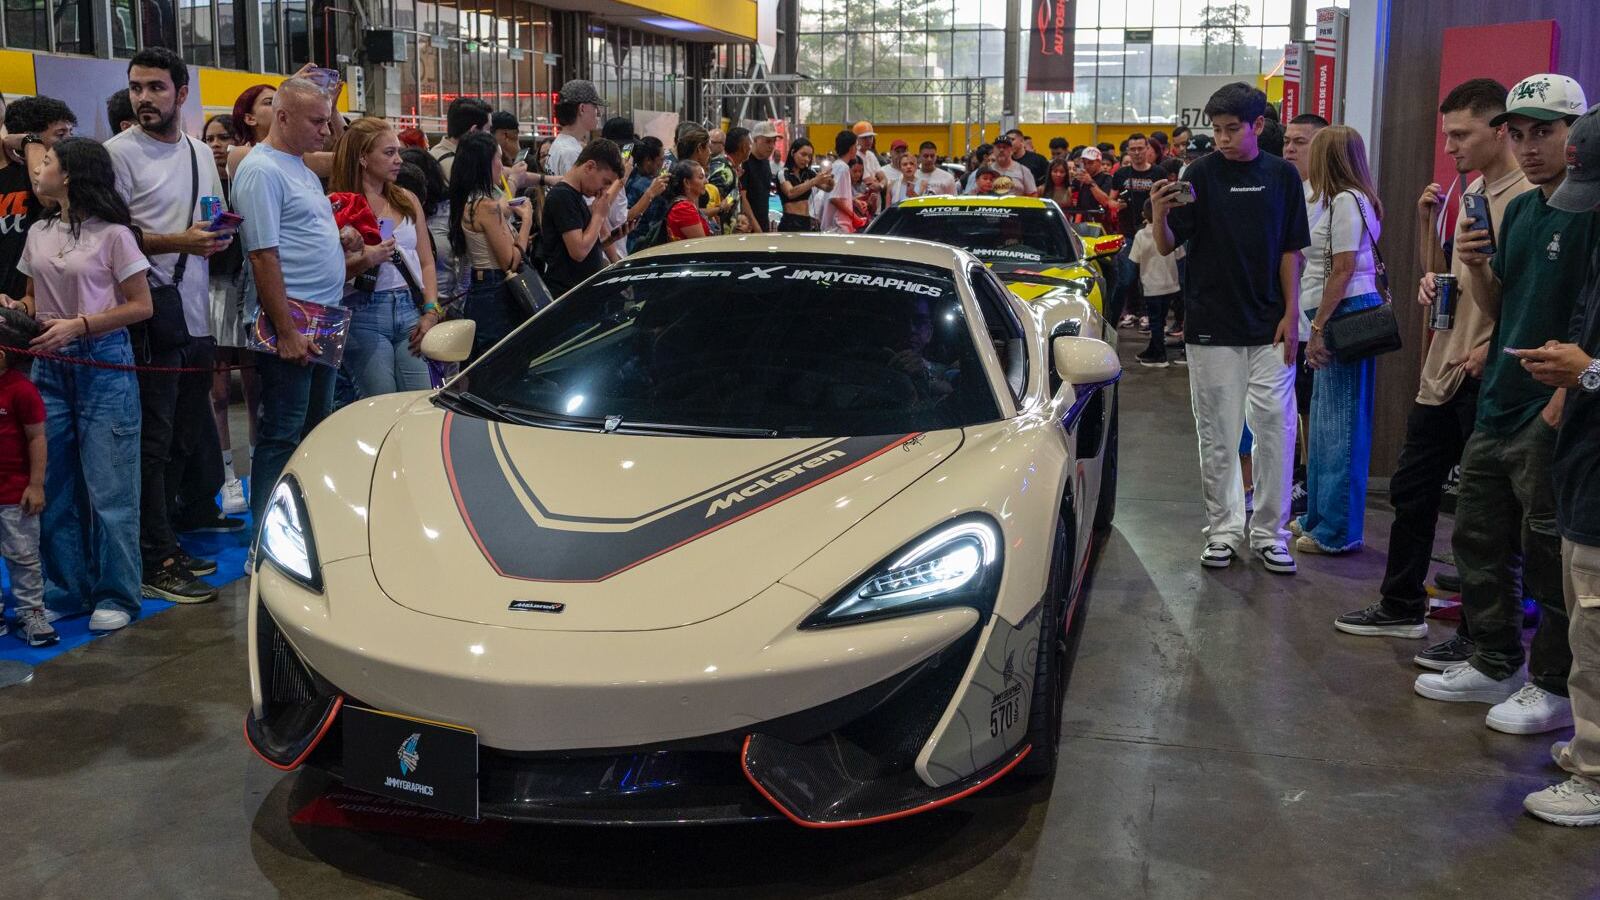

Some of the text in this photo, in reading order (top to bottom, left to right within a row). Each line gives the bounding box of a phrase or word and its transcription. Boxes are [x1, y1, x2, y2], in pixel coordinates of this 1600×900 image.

[592, 269, 732, 286] McLaren
[784, 269, 943, 298] JIMMYGRAPHICS
[705, 450, 848, 518] McLaren
[990, 701, 1013, 738] 570
[384, 776, 434, 796] JIMMYGRAPHICS
